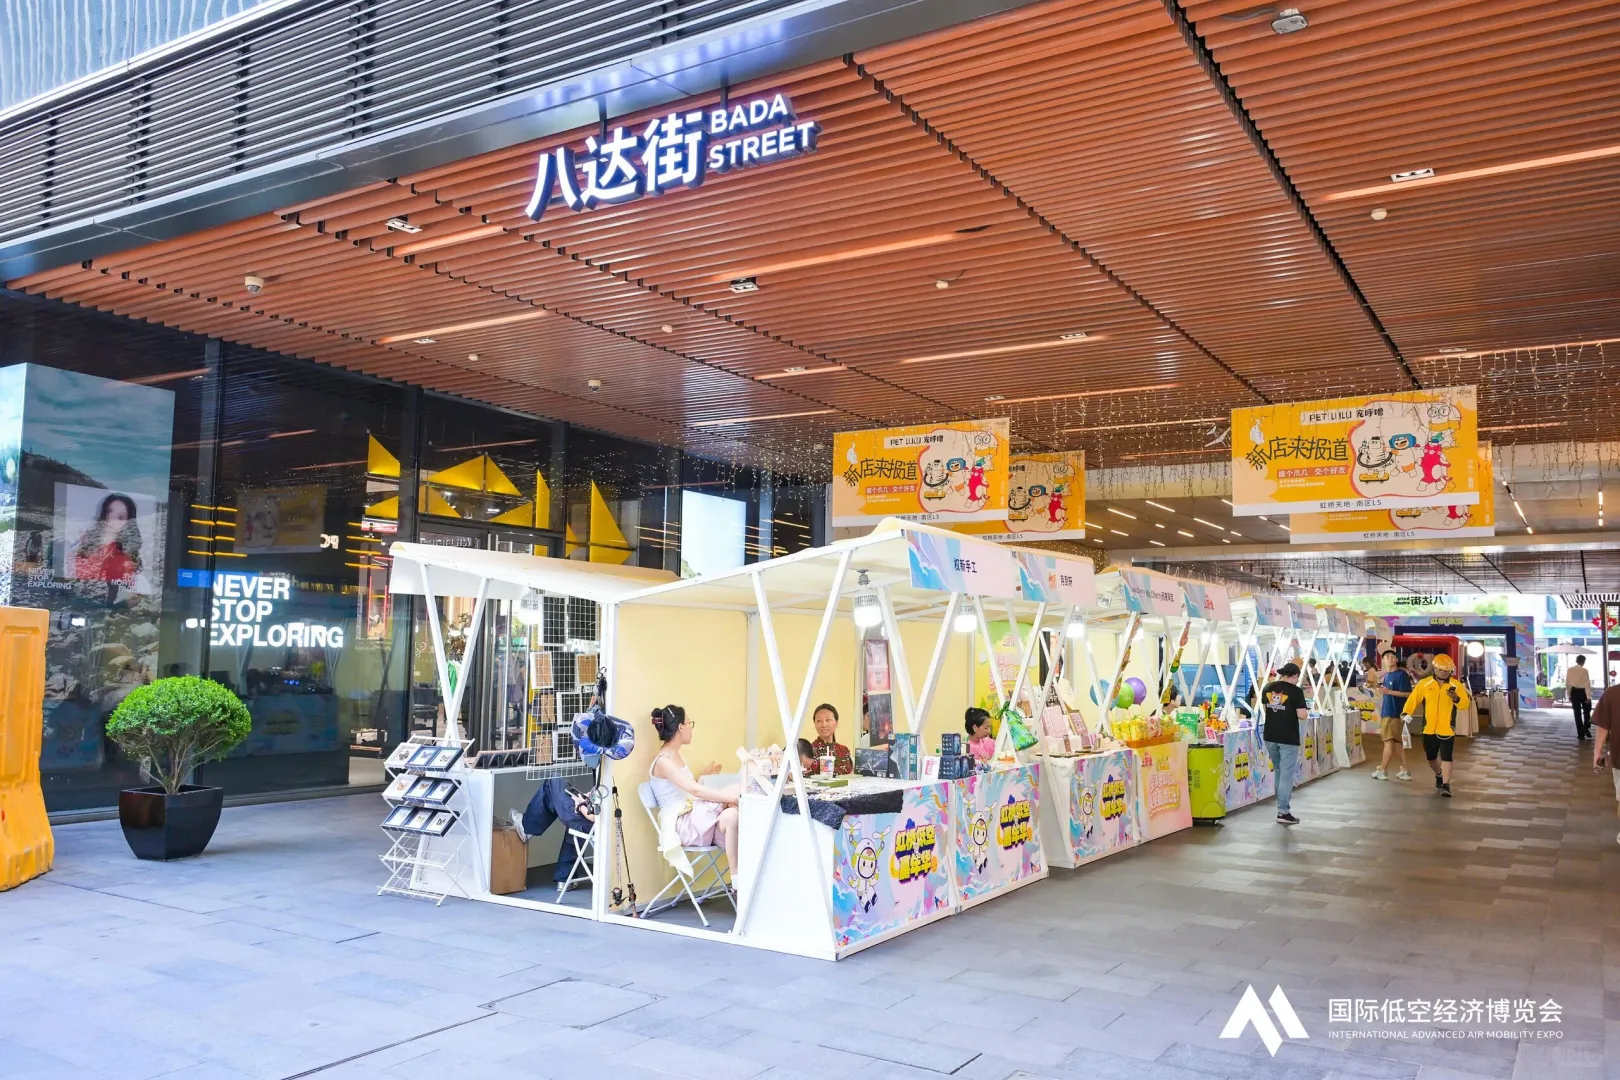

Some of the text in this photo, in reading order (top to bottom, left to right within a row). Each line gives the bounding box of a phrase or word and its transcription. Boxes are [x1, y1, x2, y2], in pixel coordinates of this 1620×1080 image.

[710, 93, 788, 134] BADA
[709, 121, 815, 169] STREET
[525, 111, 703, 222] 八达街
[1309, 413, 1327, 422] PET
[1245, 435, 1349, 471] 新店来报道
[843, 456, 918, 487] 新店来报道
[1314, 466, 1346, 476] 交个好友
[28, 567, 55, 575] NEVER
[27, 580, 72, 590] EXPLORING
[212, 573, 290, 600] NEVER
[211, 599, 273, 623] STOP
[209, 623, 344, 648] EXPLORING
